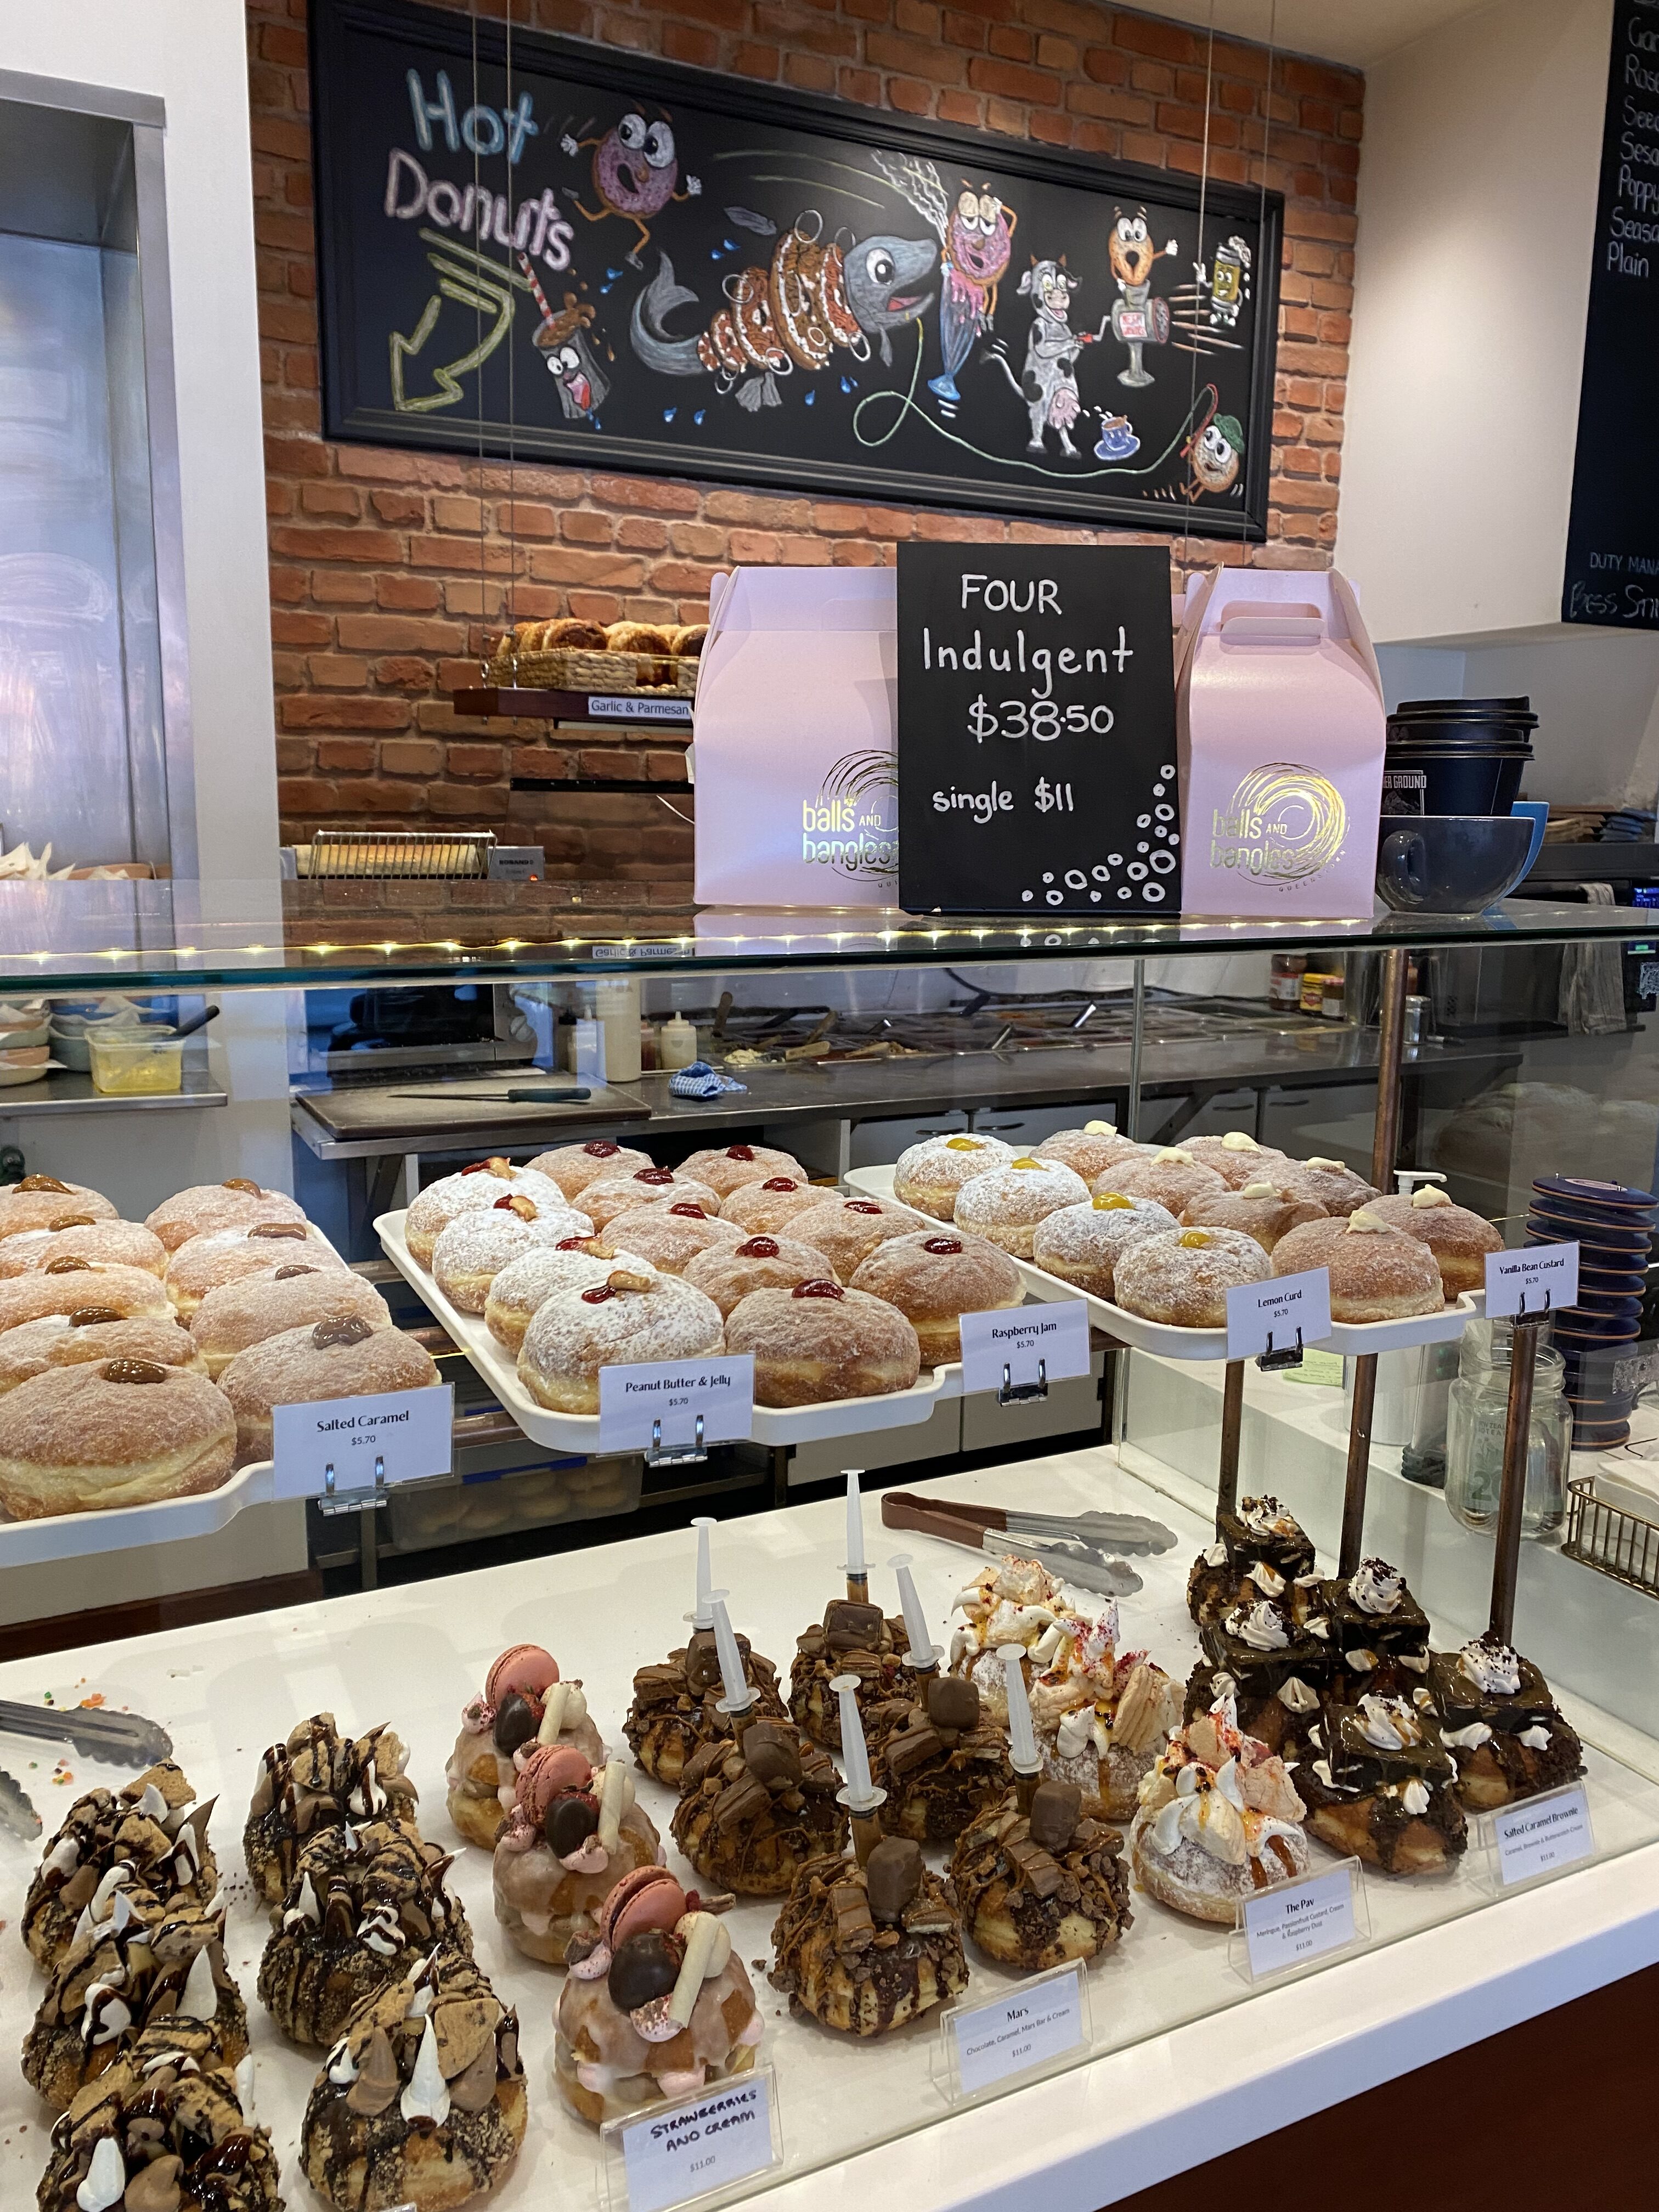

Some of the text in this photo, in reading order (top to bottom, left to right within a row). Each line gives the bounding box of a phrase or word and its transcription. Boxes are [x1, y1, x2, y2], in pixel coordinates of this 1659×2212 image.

[407, 67, 539, 164] Hot
[385, 148, 574, 271] Donuts
[1607, 241, 1649, 278] Plain
[1590, 552, 1623, 571] DUTY
[961, 574, 1062, 615] FOUR
[923, 626, 1134, 699] Indulgent
[591, 699, 689, 715] Garlic & Parmesan
[967, 693, 1114, 744] $38.50
[1393, 775, 1426, 788] GROUND
[933, 777, 1074, 823] single $11
[803, 799, 881, 832] balls AND
[1212, 809, 1288, 839] balls AND
[803, 832, 891, 871] bangles
[1210, 840, 1295, 876] bangles
[1499, 1258, 1564, 1274] Vanilla Bean Custard
[1258, 1289, 1302, 1308] Lemon Curd
[1274, 1308, 1288, 1317] $5.70
[992, 1323, 1057, 1339] Raspberry Jam
[1017, 1340, 1034, 1348] $5.70
[625, 1375, 731, 1392] Peanut Butter & Jelly
[669, 1397, 689, 1406] $5.70
[317, 1410, 409, 1432] Salted Caramel
[351, 1435, 376, 1446] $5.70
[1504, 1807, 1578, 1839] Salted Caramel Brownie
[1285, 1898, 1314, 1914] The Pav
[1296, 1940, 1312, 1951] $11.00
[1007, 2007, 1029, 2022] Mars
[967, 2040, 996, 2056] Chocolate,
[1022, 2023, 1035, 2033] Mars
[1052, 2008, 1070, 2019] Cream
[1012, 2044, 1031, 2057] $11.00
[650, 2089, 757, 2140] STRAWBERRIES
[704, 2109, 755, 2136] CREAM
[690, 2155, 715, 2172] $11.00
